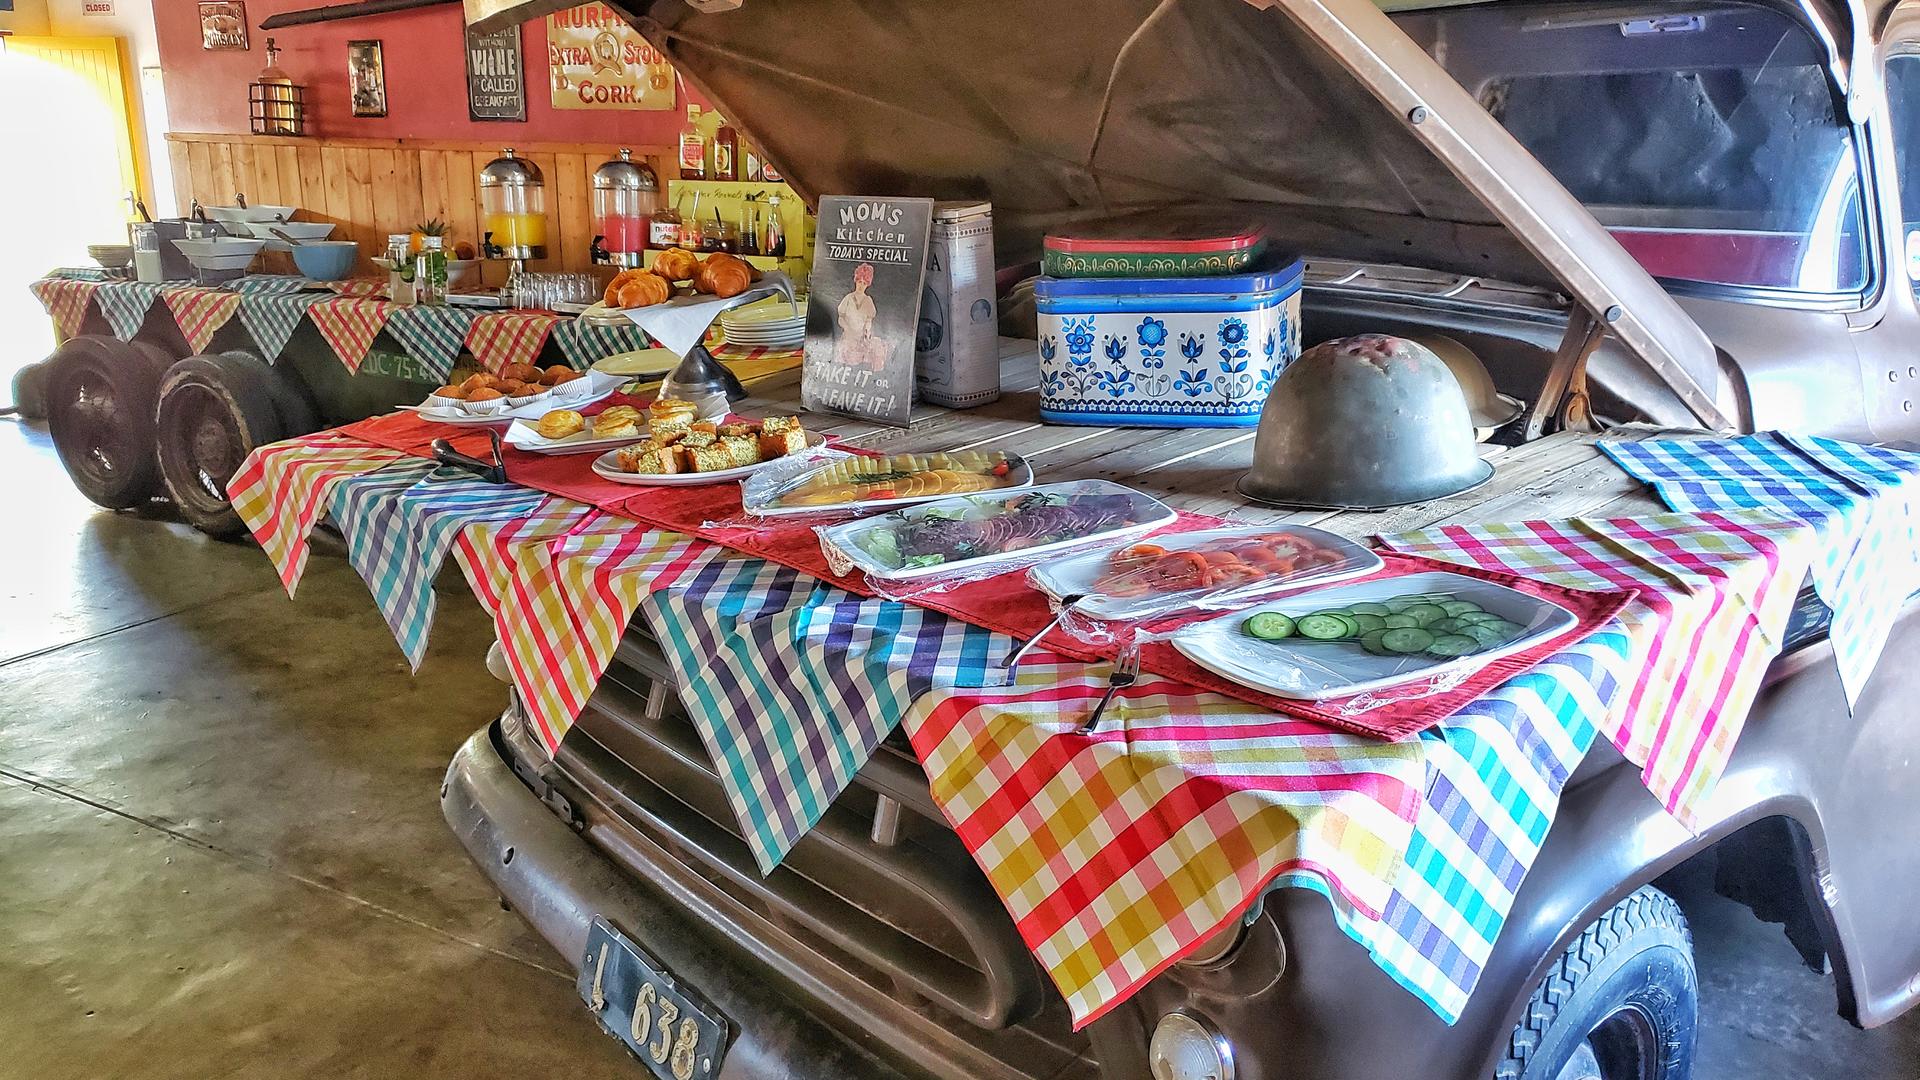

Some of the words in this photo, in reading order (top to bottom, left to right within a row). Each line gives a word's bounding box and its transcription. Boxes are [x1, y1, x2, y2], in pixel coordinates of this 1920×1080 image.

[85, 4, 111, 12] CLOSED
[471, 48, 515, 76] WINE
[551, 42, 593, 65] EXTRA
[623, 40, 668, 65] STOU
[481, 79, 517, 93] CALLED
[475, 95, 518, 107] BREAKFAST
[836, 227, 905, 244] Kitchen
[866, 248, 908, 262] SPECIAL
[815, 361, 852, 385] TAKE
[854, 369, 873, 389] IT
[876, 379, 889, 389] OR
[821, 388, 865, 412] LEAVE
[631, 982, 699, 1080] 638
